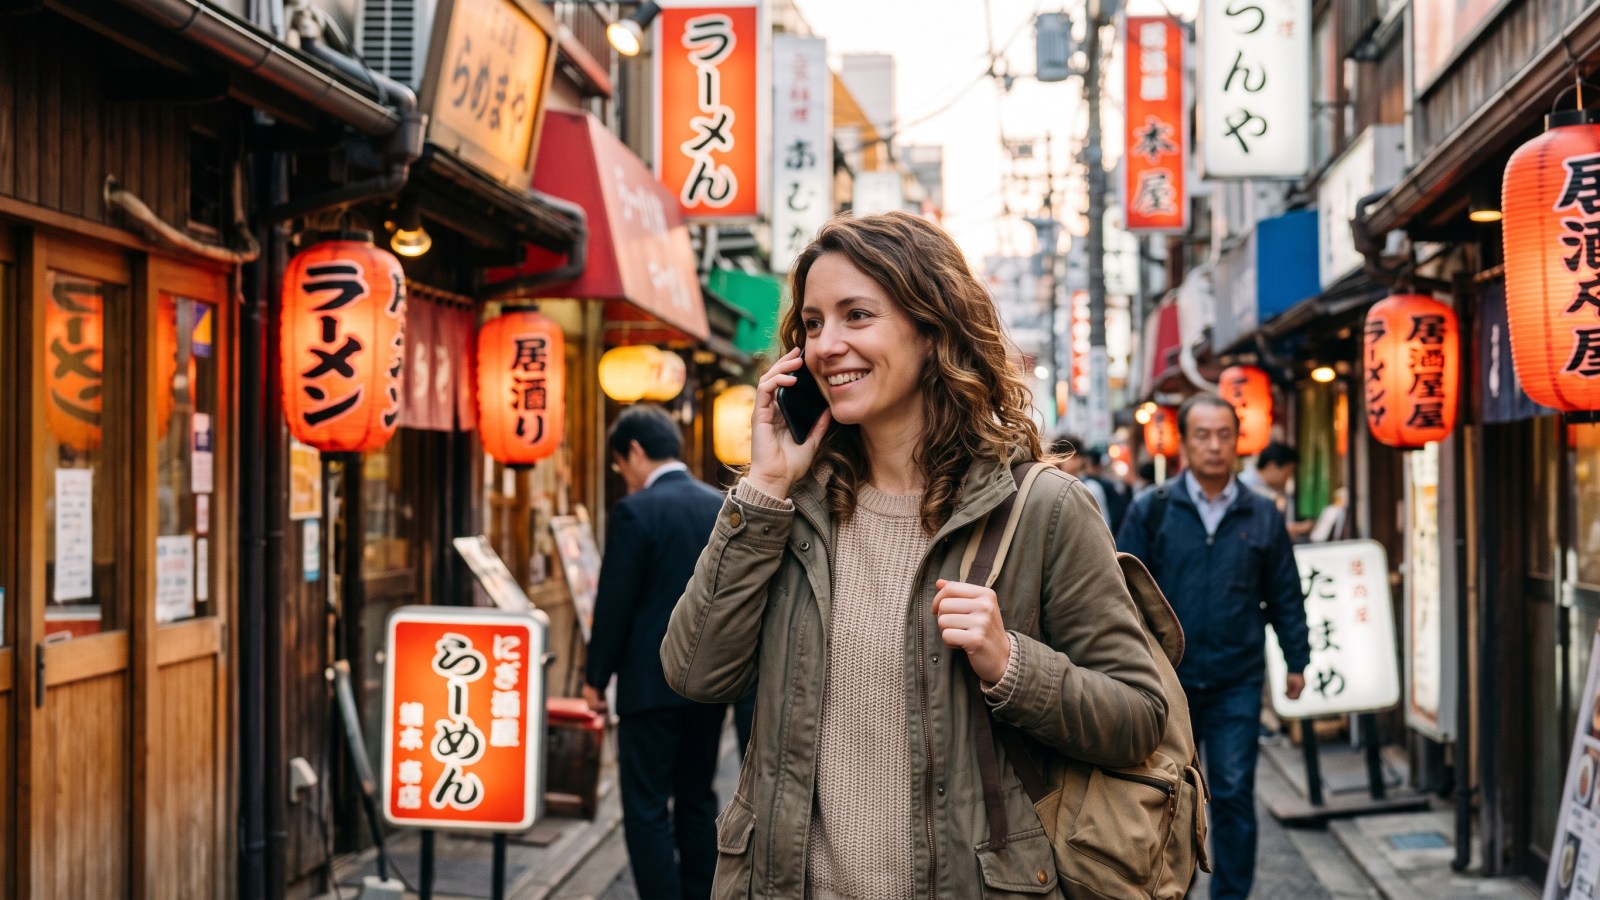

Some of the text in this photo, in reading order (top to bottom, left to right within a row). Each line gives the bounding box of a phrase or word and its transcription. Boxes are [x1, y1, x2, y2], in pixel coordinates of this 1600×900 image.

[686, 18, 732, 203] ラーメん
[302, 265, 364, 427] ラーメン
[433, 635, 483, 806] らーめん
